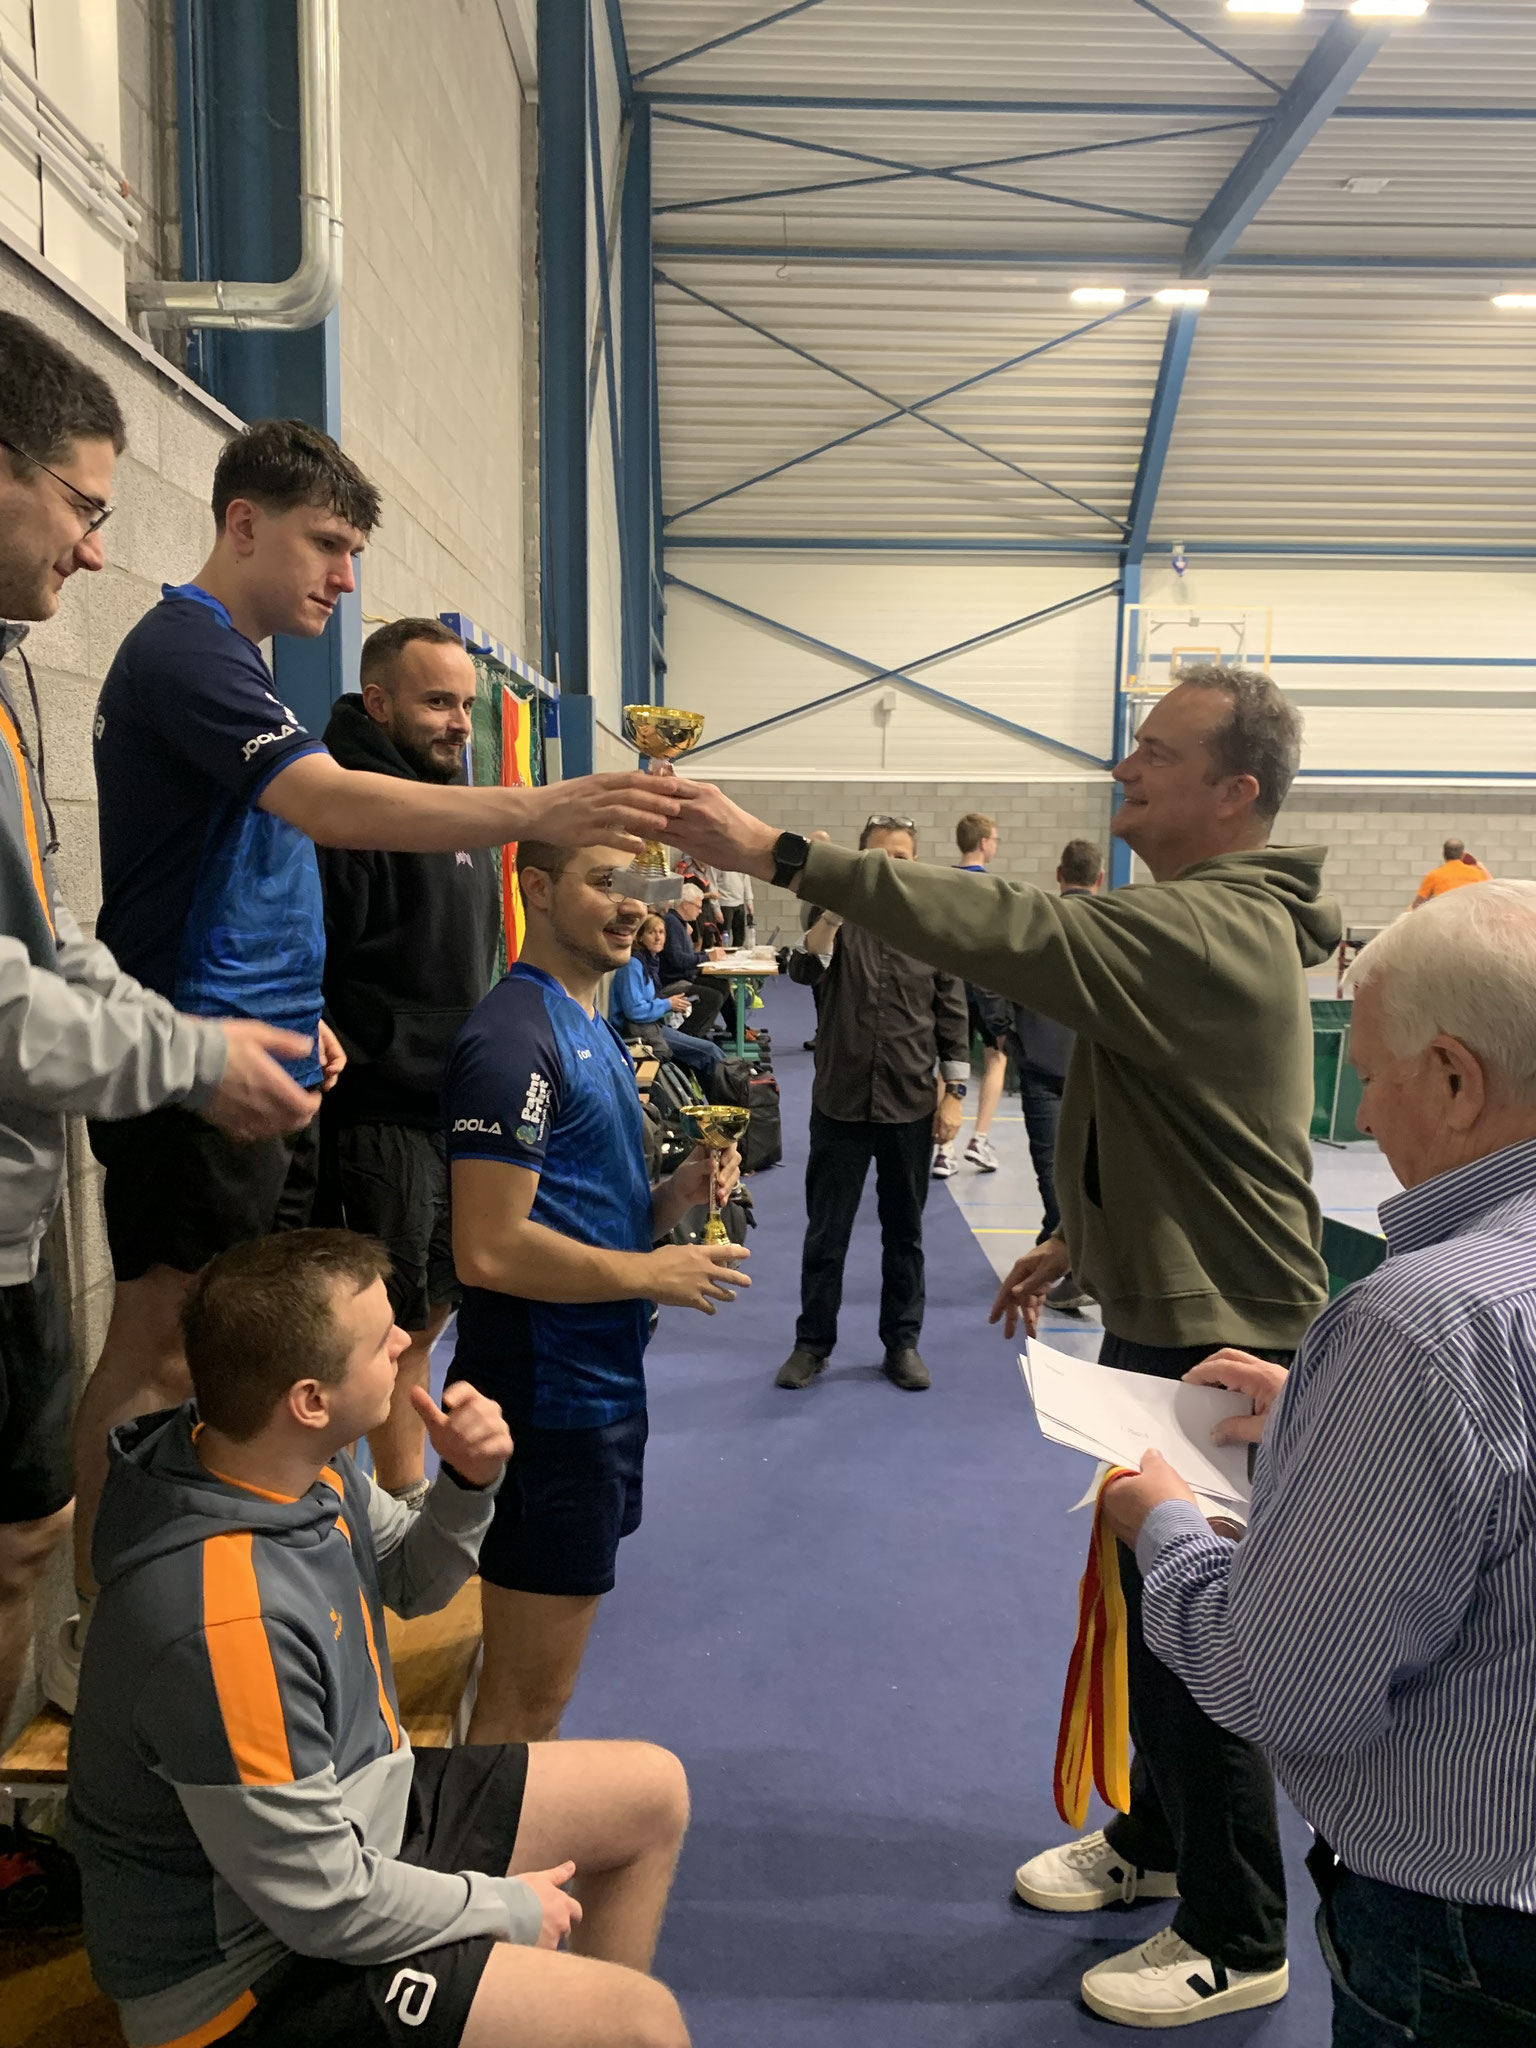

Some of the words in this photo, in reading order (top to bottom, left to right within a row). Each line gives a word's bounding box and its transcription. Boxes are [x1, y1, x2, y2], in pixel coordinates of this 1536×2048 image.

[241, 724, 297, 762] JOOLA
[521, 1072, 541, 1121] Paint
[530, 1080, 549, 1124] Print
[452, 1118, 502, 1136] JOOLA
